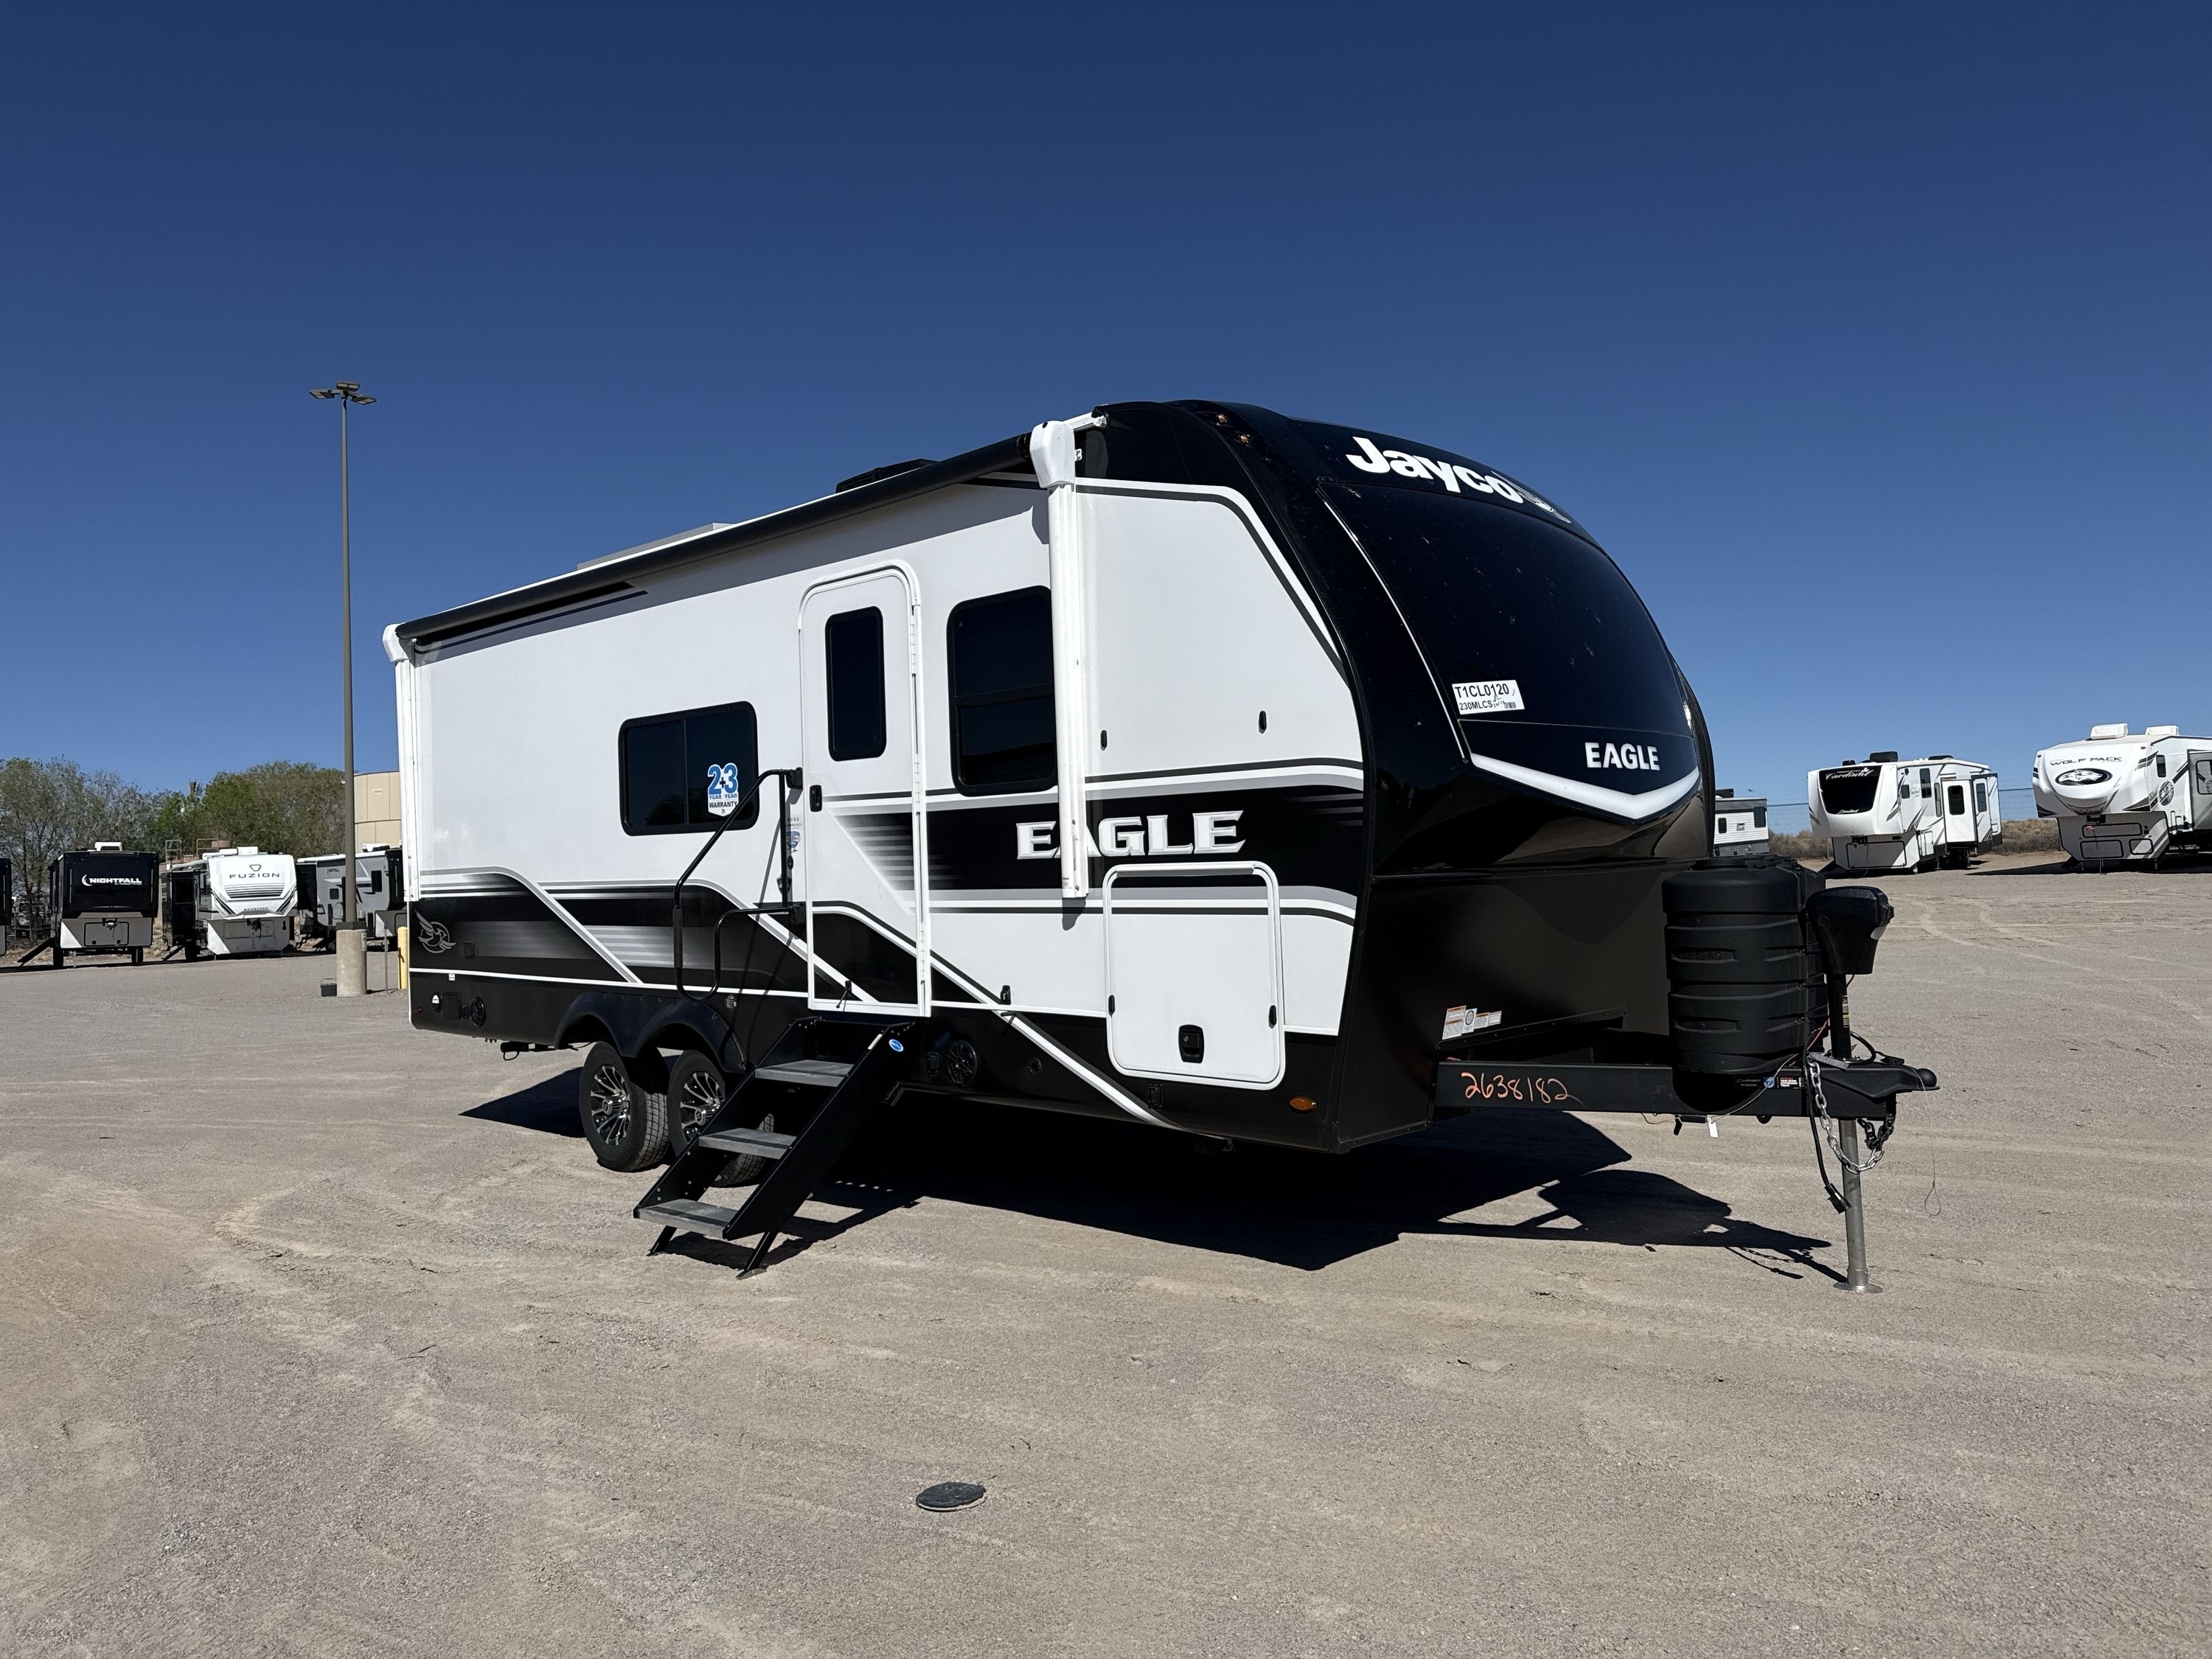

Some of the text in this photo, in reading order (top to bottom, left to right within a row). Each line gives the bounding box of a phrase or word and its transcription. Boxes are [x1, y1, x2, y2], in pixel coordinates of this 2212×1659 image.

[1346, 436, 1524, 504] Jayco
[1454, 683, 1509, 699] T1CL0120
[1459, 700, 1493, 711] 230MLCS
[1585, 742, 1660, 771] EAGLE
[2050, 758, 2087, 766] WOLF
[1461, 1072, 1582, 1105] 2638182
